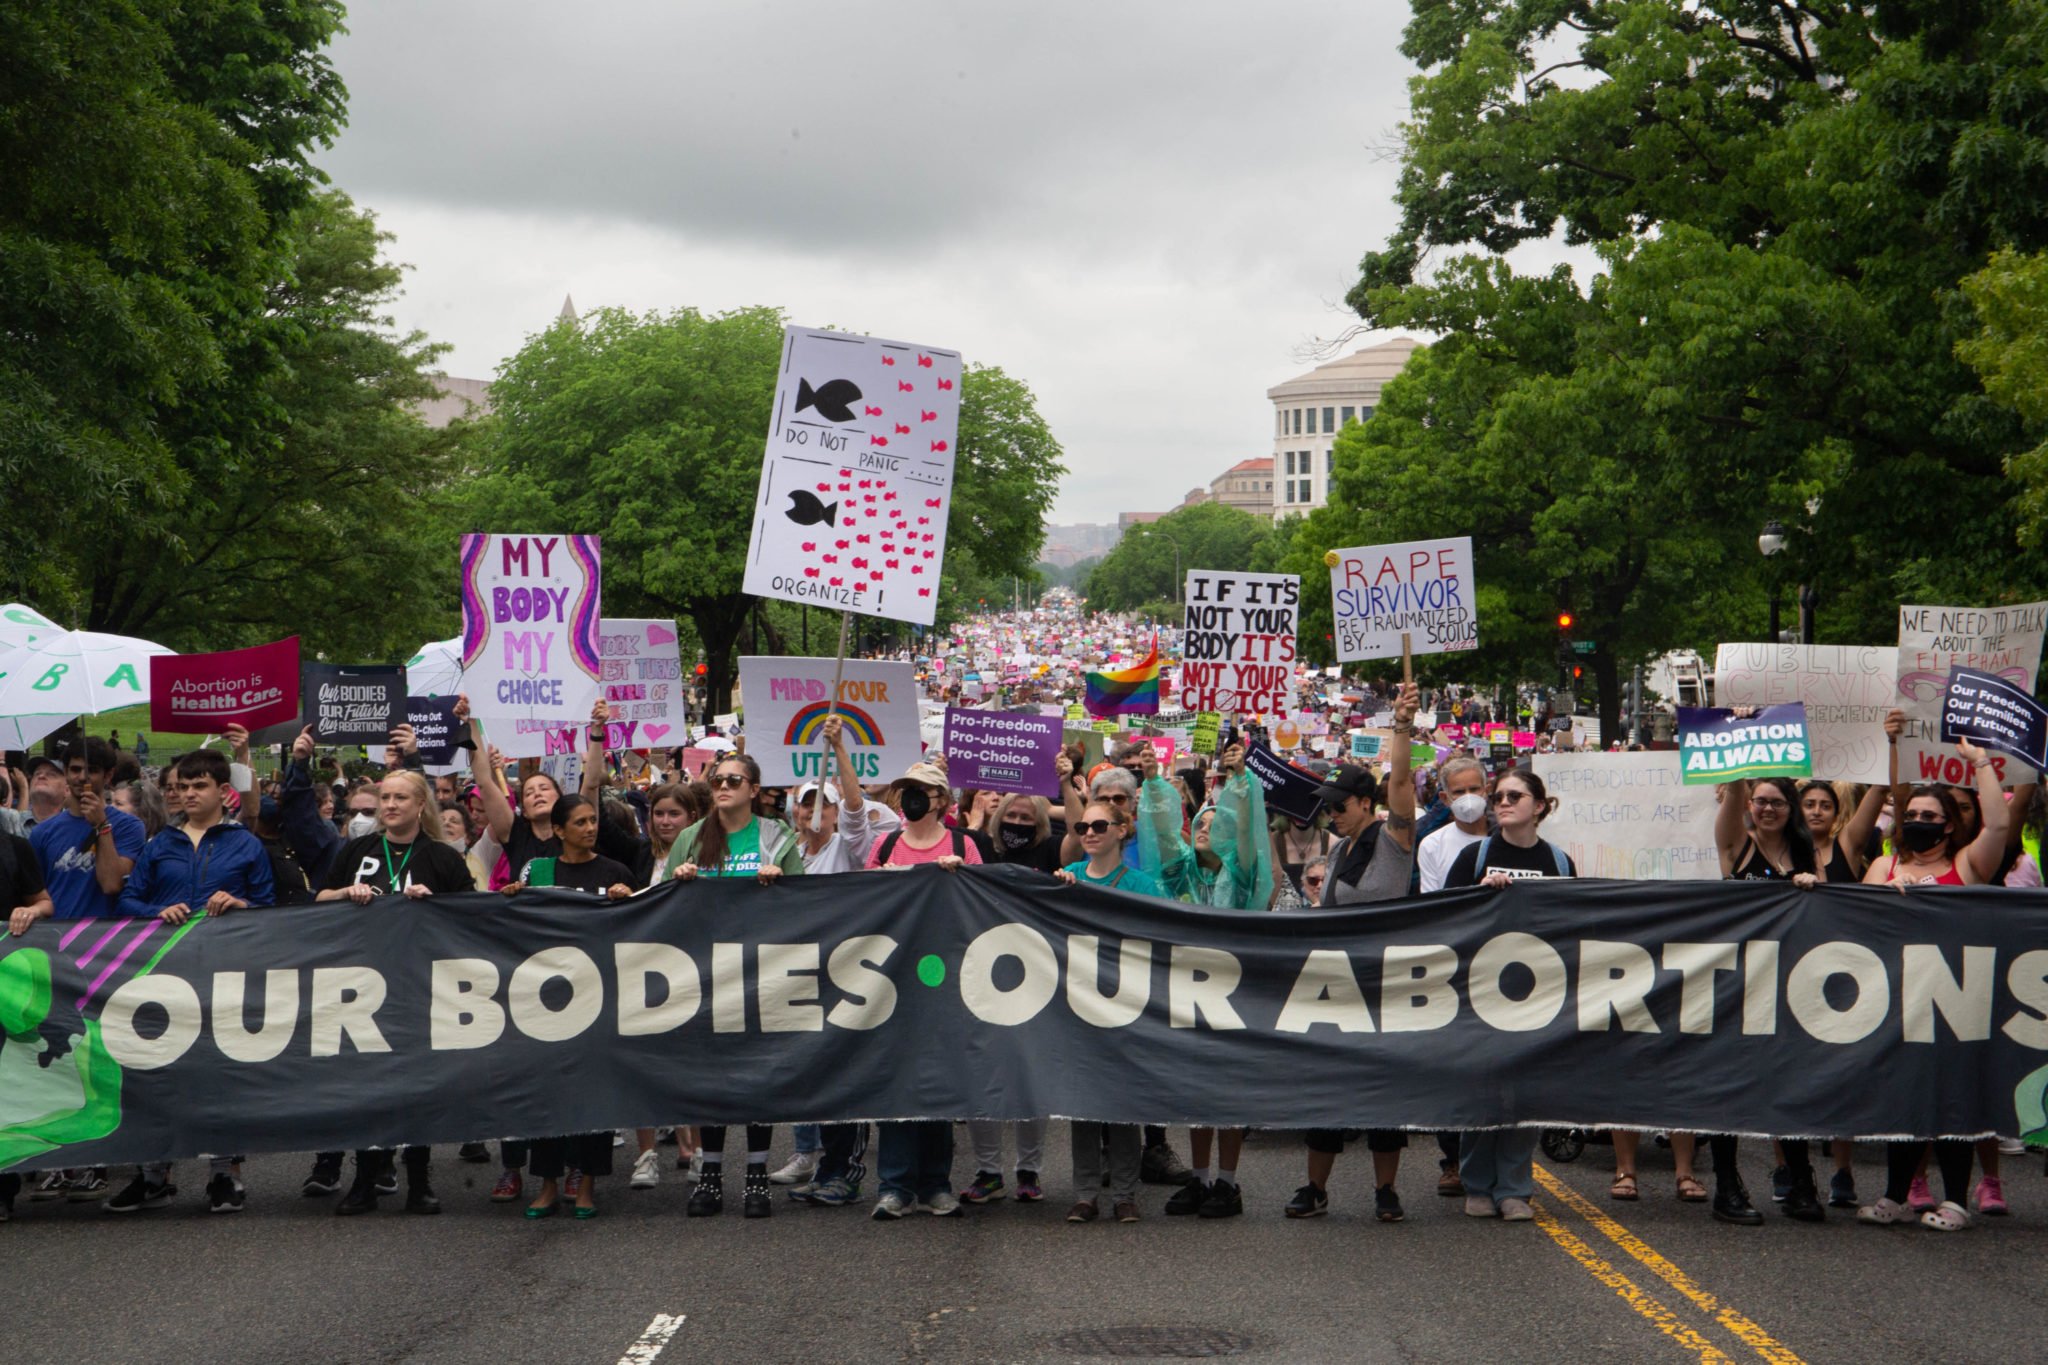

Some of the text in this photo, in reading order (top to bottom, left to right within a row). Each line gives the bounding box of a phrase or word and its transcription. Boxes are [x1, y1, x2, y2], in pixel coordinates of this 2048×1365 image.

[786, 428, 900, 472] DO NOT PANIC
[501, 537, 559, 577] MY
[1344, 549, 1457, 589] RAPE
[771, 576, 863, 607] ORGANIZE
[1193, 577, 1299, 605] IF IT'S
[1336, 577, 1461, 618] SURVIVOR
[492, 586, 570, 624] BODY
[1186, 605, 1294, 635] NOT YOUR
[1338, 606, 1468, 636] RETRAUMATIZED
[1427, 620, 1479, 644] SCOTUS
[1903, 606, 2047, 636] WE NEED TO TALK
[503, 630, 555, 673] MY
[1184, 630, 1296, 662] BODY IT'S
[1443, 640, 1477, 651] 2022
[1931, 634, 2006, 652] ABOUT THE
[1720, 642, 1882, 676] PUBLIC
[1916, 647, 2025, 672] ELEPHANT
[171, 672, 262, 693] Abortion is
[770, 676, 890, 703] MIND YOUR
[1182, 662, 1289, 691] NOT YOUR
[1725, 668, 1898, 708] CERVIX
[171, 687, 282, 709] Health Care.
[318, 682, 386, 703] Our BODIES
[496, 679, 563, 705] CHOICE
[651, 683, 668, 700] OF
[1951, 684, 2034, 721] Our Freedom.
[319, 701, 391, 721] OUR Futures
[407, 711, 442, 722] Vote Out
[951, 713, 1051, 734] Pro-Freedom.
[1948, 697, 2030, 732] Our Families.
[318, 717, 388, 733] Our ABORTIONS
[413, 723, 449, 736] ti-Choice
[1683, 723, 1804, 748] ABORTION
[1904, 718, 1934, 743] IN
[1945, 711, 2019, 740] Our Future.
[415, 737, 446, 748] iticians
[544, 728, 578, 757] MY
[950, 730, 1040, 750] Pro-Justice.
[792, 752, 880, 778] UTEUS
[948, 746, 1035, 766] Pro-Choice.
[1686, 742, 1807, 771] ALWAYS
[991, 769, 1020, 777] NARAL
[1246, 755, 1286, 786] Abortion
[1547, 767, 1682, 793] REPRODUCTIV
[1572, 803, 1691, 825] RIGHTS ARE
[101, 922, 2048, 1071] OUR BODIES OUR ABORTIONS
